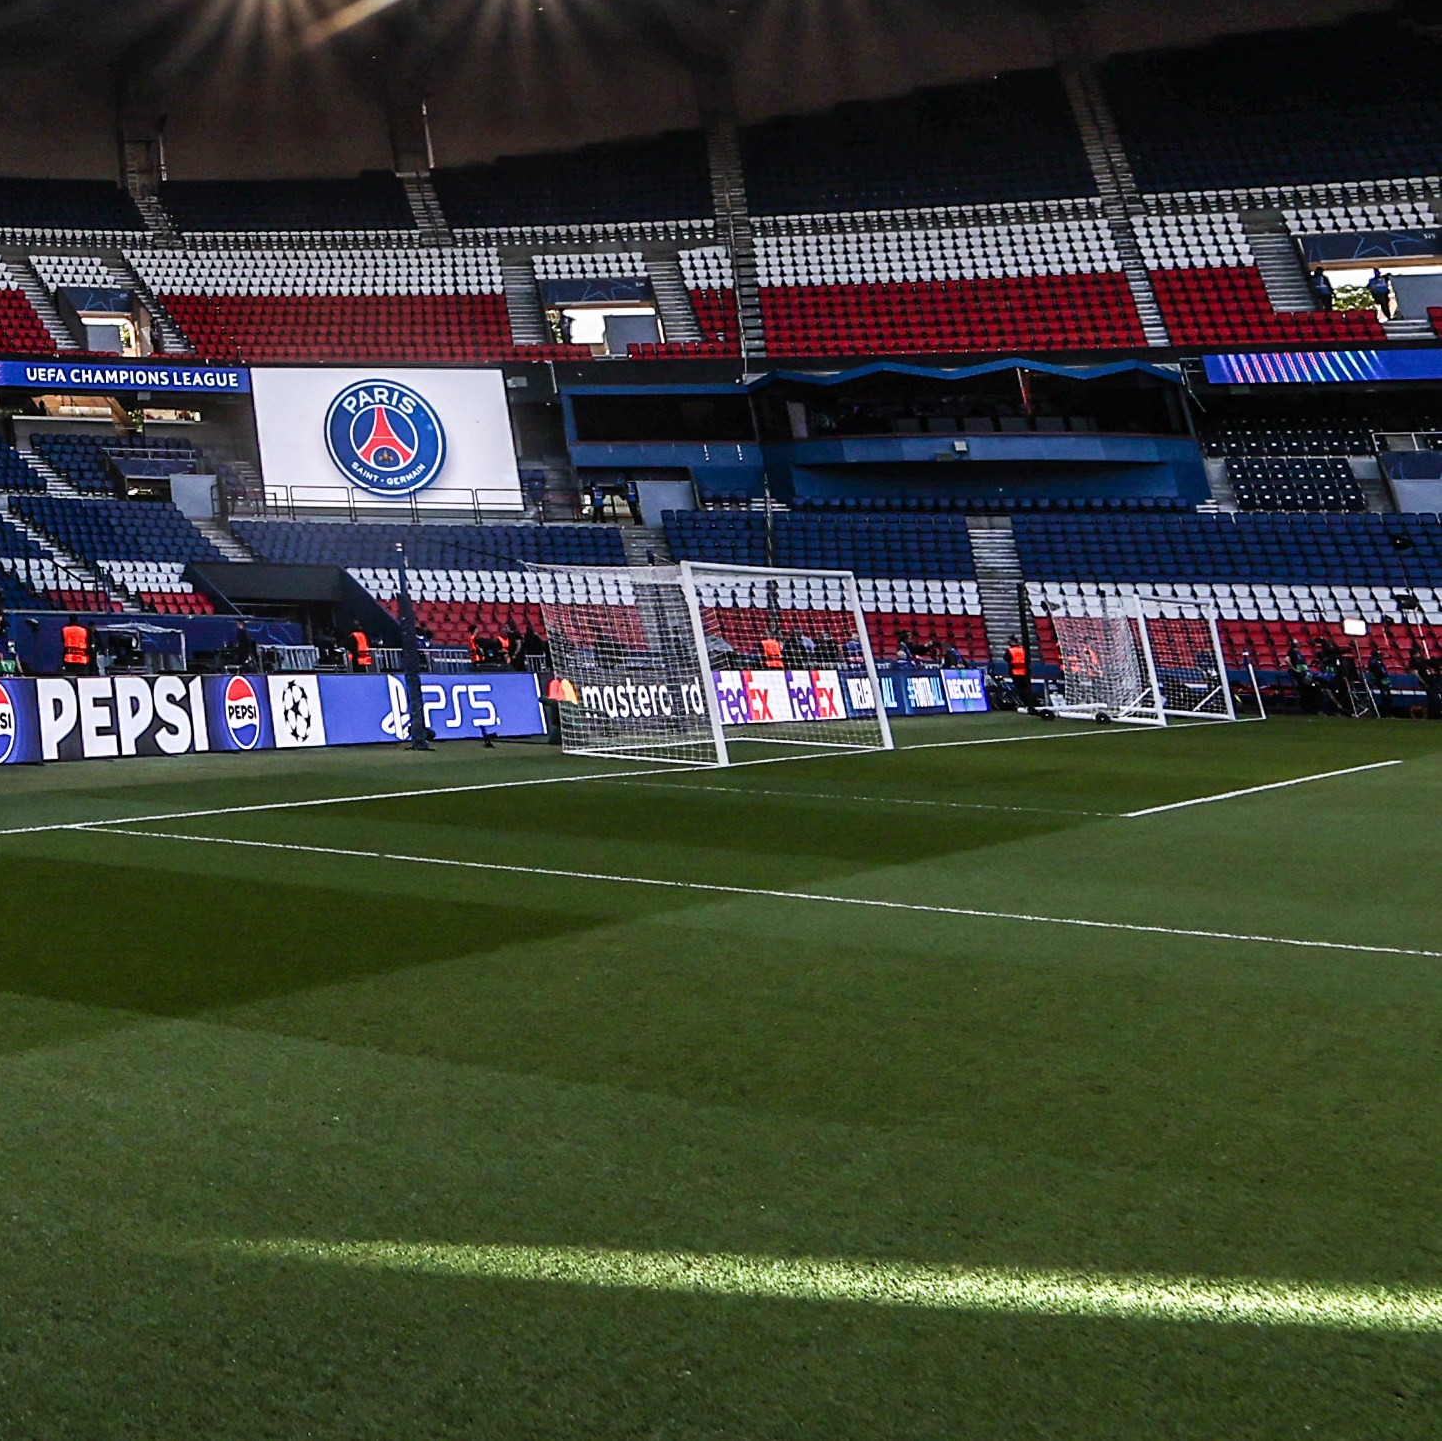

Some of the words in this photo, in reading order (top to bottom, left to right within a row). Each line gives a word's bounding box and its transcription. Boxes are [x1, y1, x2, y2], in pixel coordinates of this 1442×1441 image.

[26, 367, 66, 382] UEFA
[70, 369, 169, 385] CHAMPIONS
[173, 372, 238, 387] LEAGUE
[342, 387, 416, 414] PARIS
[420, 684, 498, 728] PS5
[712, 670, 774, 724] FedEx
[784, 670, 840, 719] FedEx
[946, 678, 983, 700] RECYCLE
[36, 675, 210, 760] PEPSI
[228, 704, 258, 721] PEPSI
